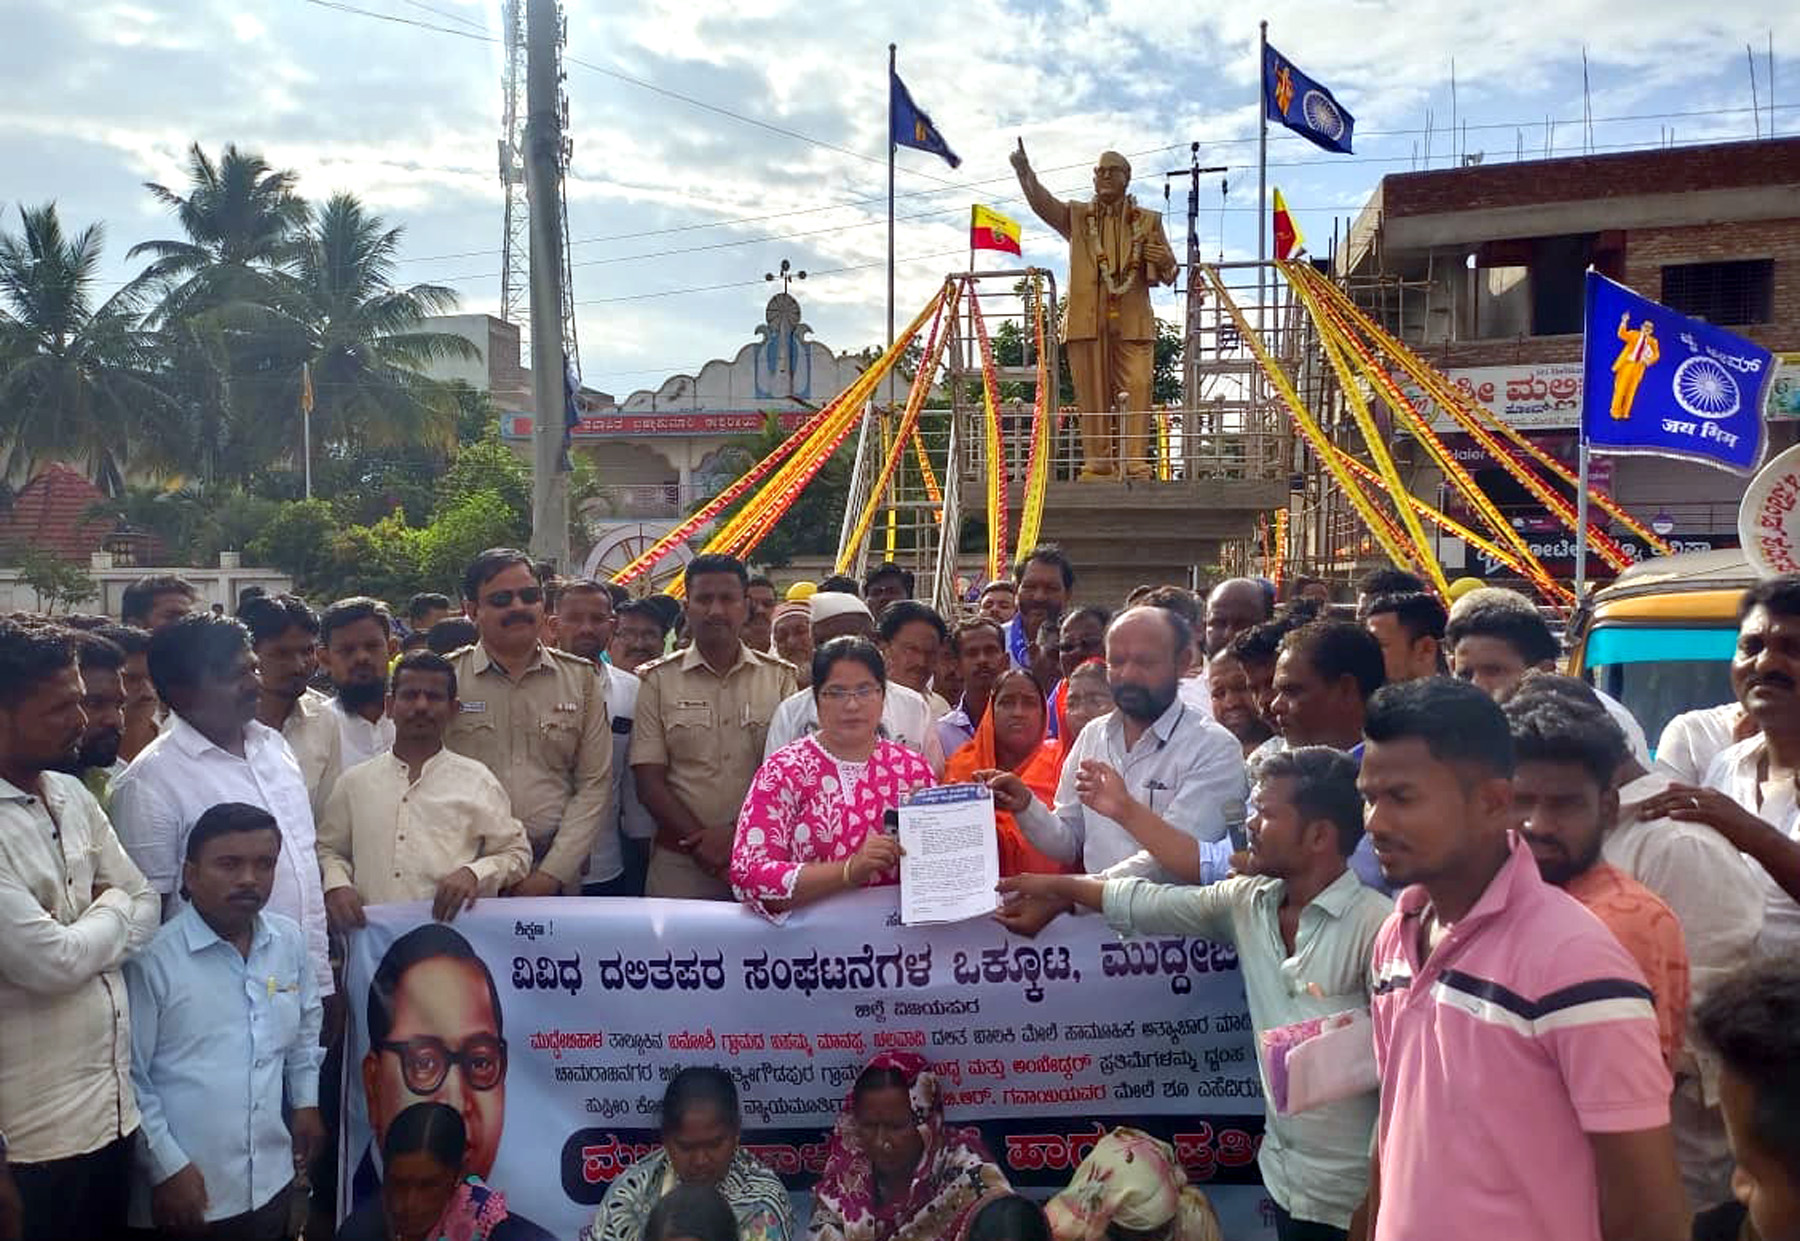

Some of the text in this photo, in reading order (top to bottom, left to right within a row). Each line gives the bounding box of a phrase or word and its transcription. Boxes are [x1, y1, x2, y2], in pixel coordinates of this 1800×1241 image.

[1506, 374, 1583, 410] ಮಲ್ಲಿ
[1662, 418, 1697, 435] जय
[512, 948, 583, 995] ವಿವಿಧ
[598, 948, 725, 990] ದಲಿತಪರ
[743, 944, 932, 996] ಸಂಘಟನೆಗಳ
[953, 939, 1081, 1001] ಒಕ್ಕೂಟ,
[895, 999, 980, 1016] ವಿಜಯಪುರ
[721, 1033, 765, 1056] ಗ್ರಾಮದ
[932, 1028, 968, 1046] ದಲಿತ
[973, 1027, 1016, 1044] ಬಾಲಕಿ
[1022, 1022, 1058, 1043] ಮೇಲೆ
[968, 1058, 1005, 1079] ಮತ್ತು
[1114, 1081, 1154, 1099] ಮೇಲೆ
